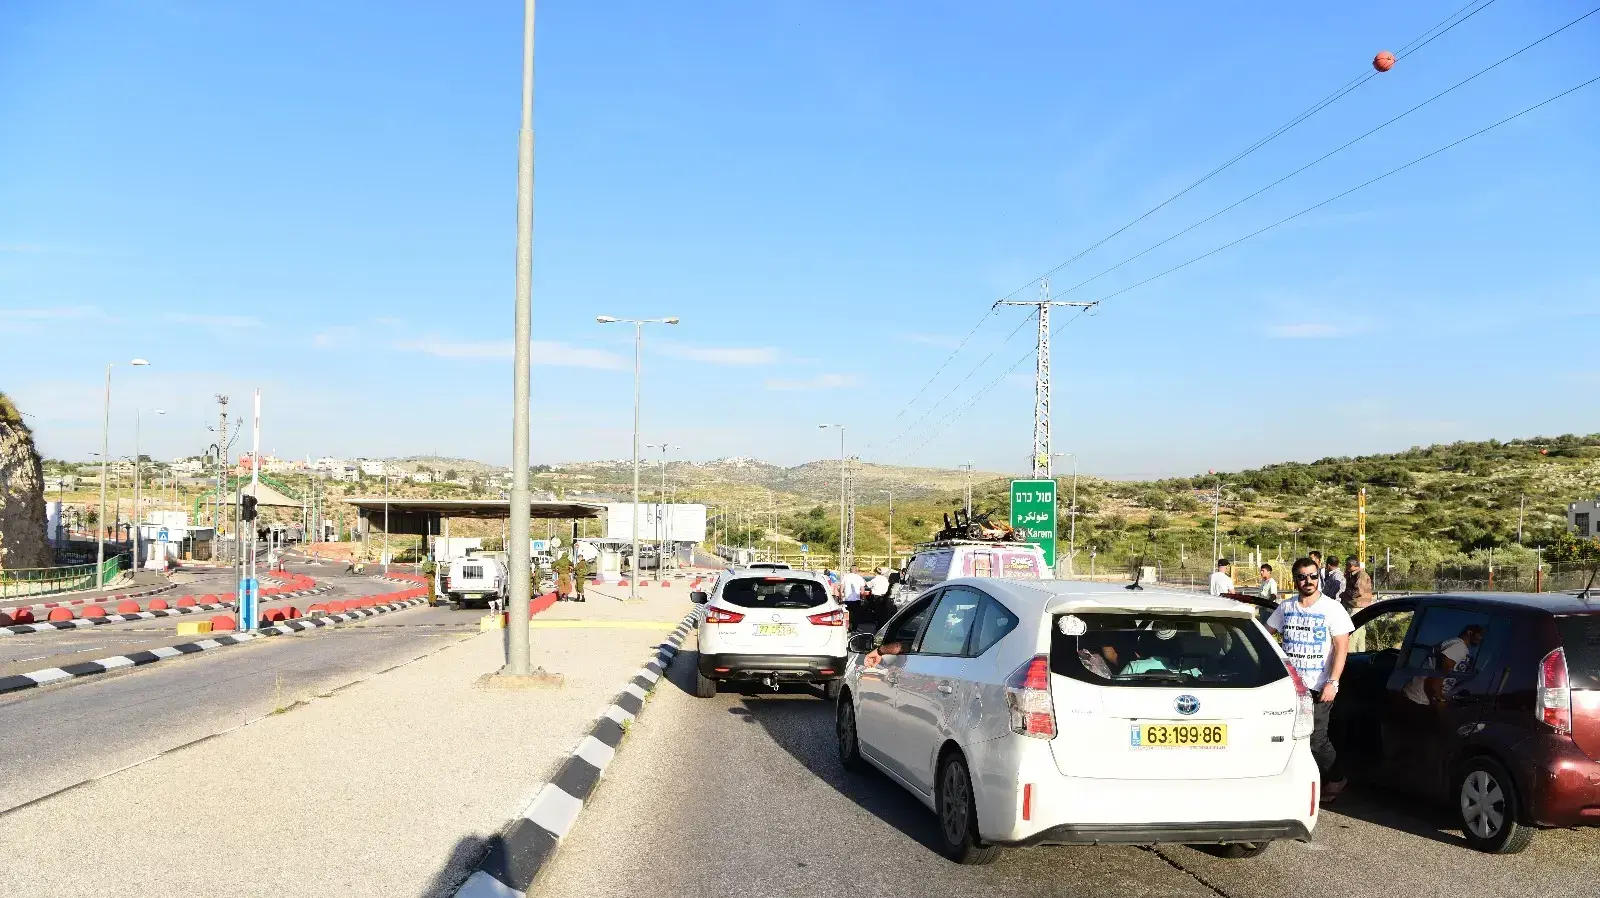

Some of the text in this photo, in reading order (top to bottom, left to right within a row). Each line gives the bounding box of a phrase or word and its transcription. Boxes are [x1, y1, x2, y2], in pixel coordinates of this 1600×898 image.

[1016, 492, 1032, 503] כרם
[1017, 512, 1049, 523] طولكرم
[1027, 528, 1053, 539] Karem
